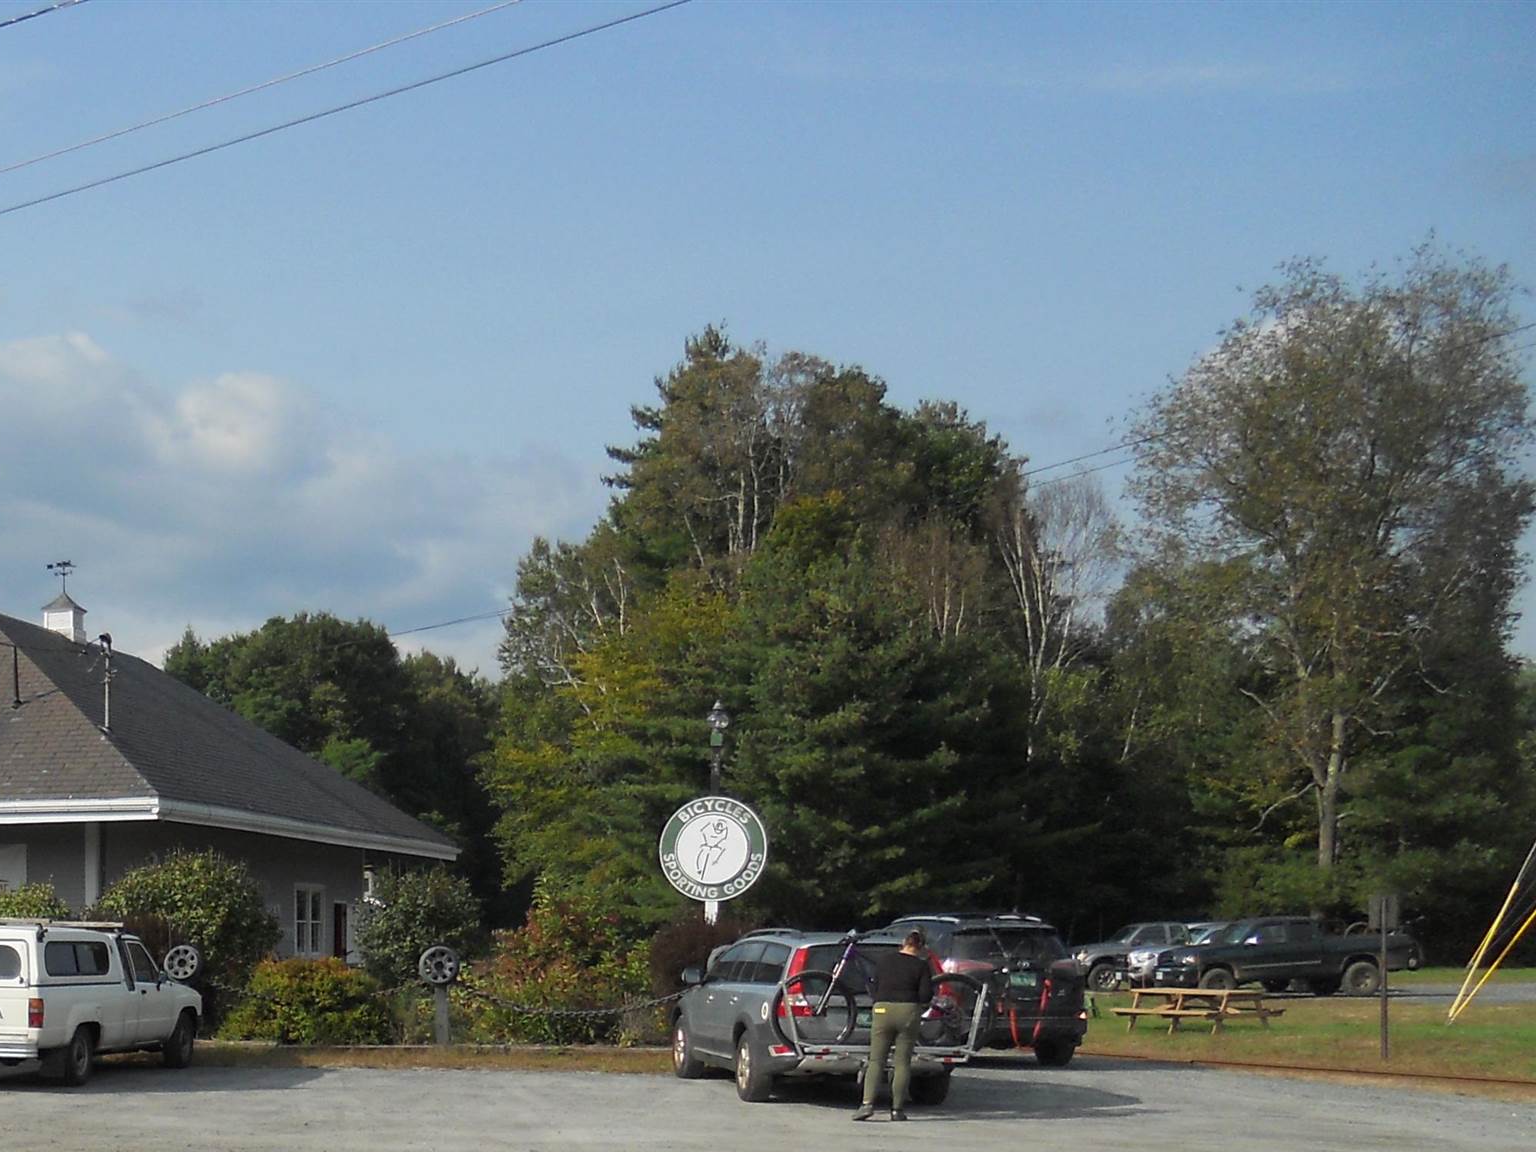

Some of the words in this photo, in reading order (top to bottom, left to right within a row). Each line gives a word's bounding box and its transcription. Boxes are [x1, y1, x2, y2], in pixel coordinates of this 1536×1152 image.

[677, 800, 751, 824] BICYCLES
[664, 853, 718, 898] SPORTING
[723, 853, 763, 895] GOODS
